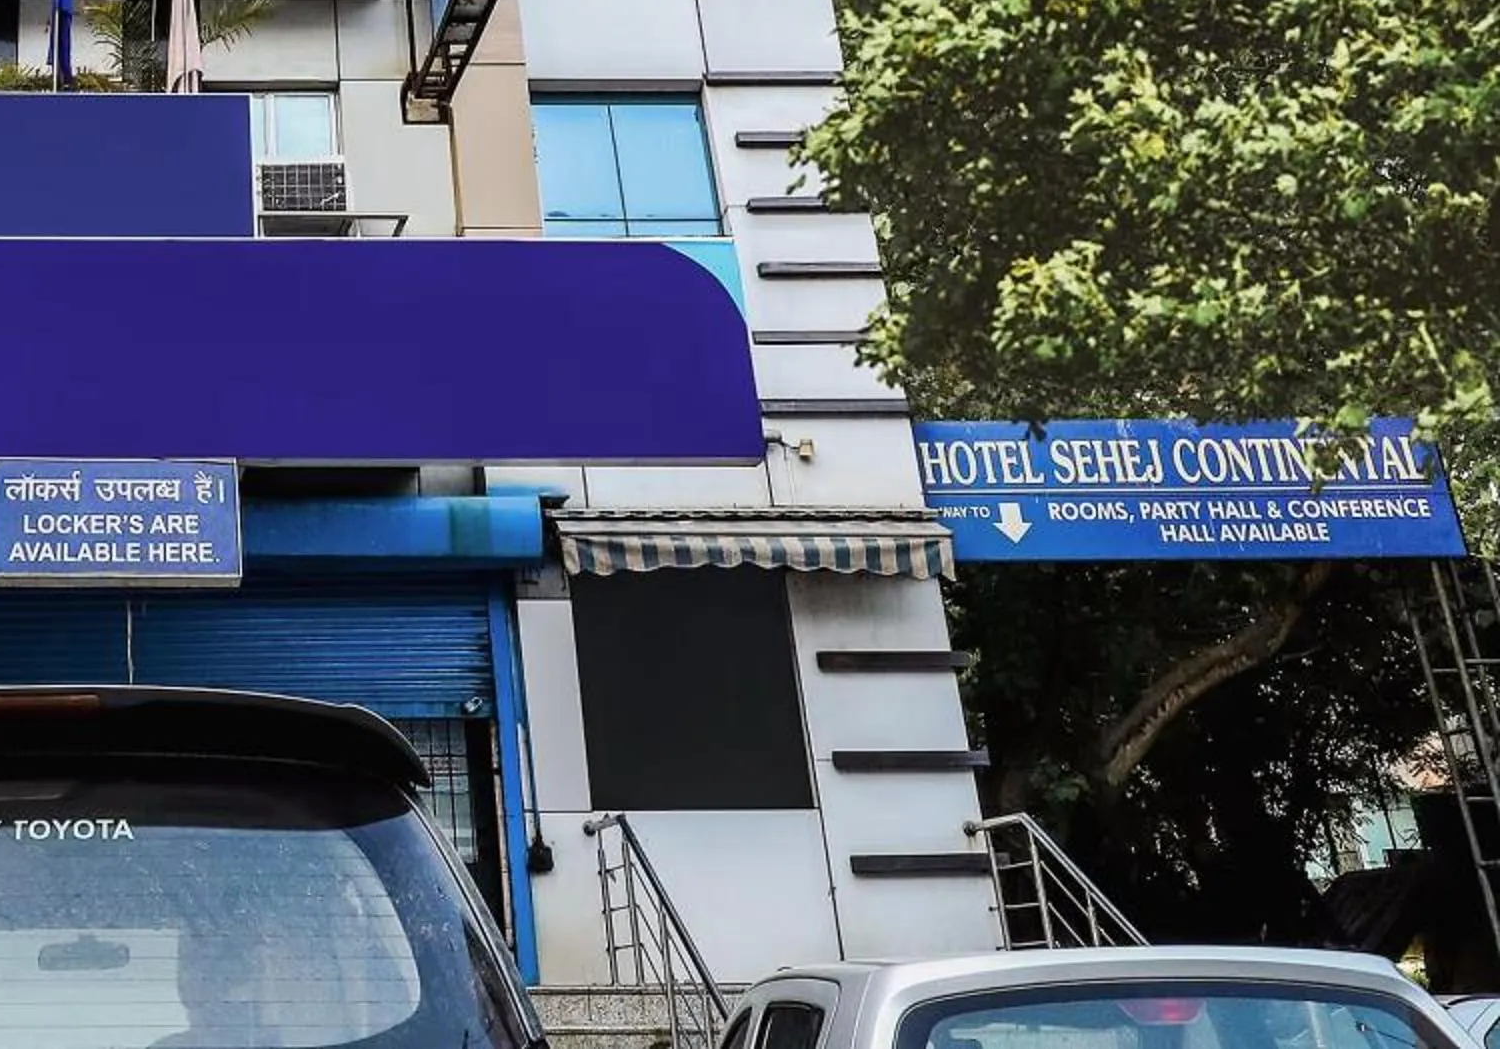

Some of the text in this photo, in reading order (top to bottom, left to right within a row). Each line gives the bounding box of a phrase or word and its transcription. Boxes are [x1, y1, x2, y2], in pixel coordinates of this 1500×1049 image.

[919, 440, 1045, 485] HOTEL
[1051, 439, 1163, 484] SEHEJ
[4, 470, 81, 502] लॉकर्स
[94, 478, 180, 502] उपलब्ध
[970, 506, 991, 518] TO
[1048, 498, 1432, 524] ROOMS, PARTY HALL & CONFERENCE
[23, 514, 199, 535] LOCKER'S ARE
[1161, 522, 1330, 543] HALL AVAILABLE
[8, 542, 221, 563] AVAILABLE HERE.
[14, 818, 135, 840] TOYOTA
